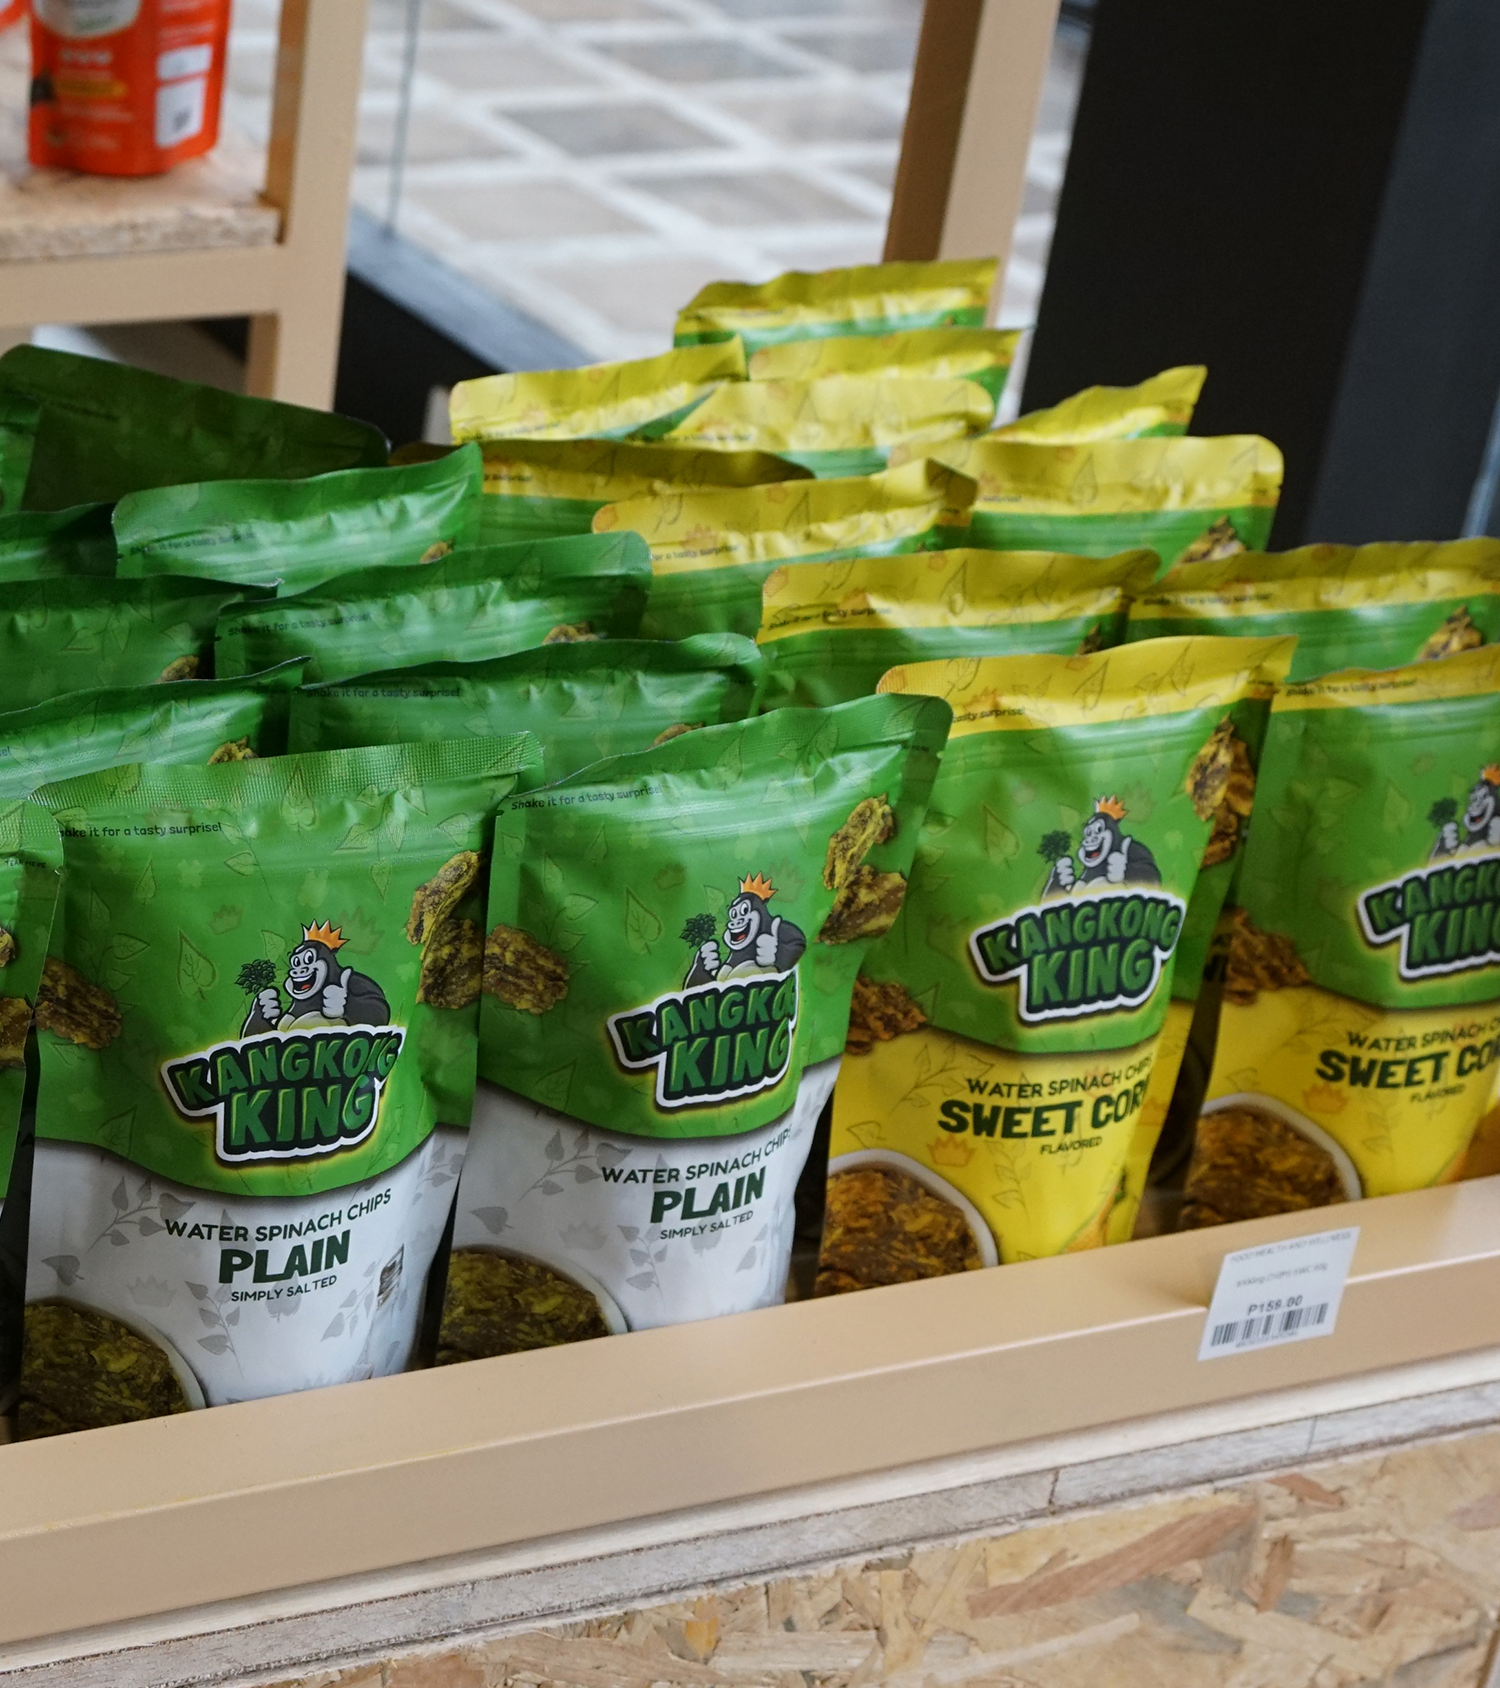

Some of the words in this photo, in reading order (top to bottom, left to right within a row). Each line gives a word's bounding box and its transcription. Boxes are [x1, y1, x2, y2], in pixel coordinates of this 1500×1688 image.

[382, 687, 412, 701] tasty
[511, 796, 546, 811] Shake
[547, 794, 558, 808] it
[559, 792, 578, 806] for
[579, 793, 587, 804] a
[587, 789, 617, 803] tasty
[60, 825, 88, 838] ake
[89, 825, 100, 837] it
[101, 825, 122, 837] for
[124, 827, 135, 837] a
[135, 823, 167, 838] tasty
[168, 820, 223, 837] surprise!
[1367, 860, 1500, 933] KANGK
[980, 897, 1183, 974] KANGKONG
[1029, 937, 1155, 1008] KING
[668, 1018, 790, 1094] KING
[1348, 1030, 1418, 1052] WATER
[172, 1035, 399, 1107] KANGKONG
[966, 1077, 1043, 1100] WATER
[1047, 1068, 1123, 1096] SPINACH
[1124, 1055, 1152, 1080] CHIP
[1315, 1049, 1450, 1090] SWEET
[228, 1074, 375, 1147] KING
[937, 1098, 1084, 1140] SWEET
[601, 1165, 680, 1185] WATER
[684, 1146, 762, 1181] SPINACH
[1039, 1135, 1103, 1155] FLAVORED
[164, 1218, 250, 1243] WATER
[254, 1207, 343, 1243] SPINACH
[346, 1187, 393, 1222] CHIPS
[649, 1165, 767, 1225] PLAIN
[659, 1224, 707, 1241] SIMPLY
[709, 1209, 755, 1233] SALTED
[217, 1228, 352, 1285] PLAIN
[230, 1286, 284, 1303] SIMPLY
[285, 1273, 338, 1298] SALTED
